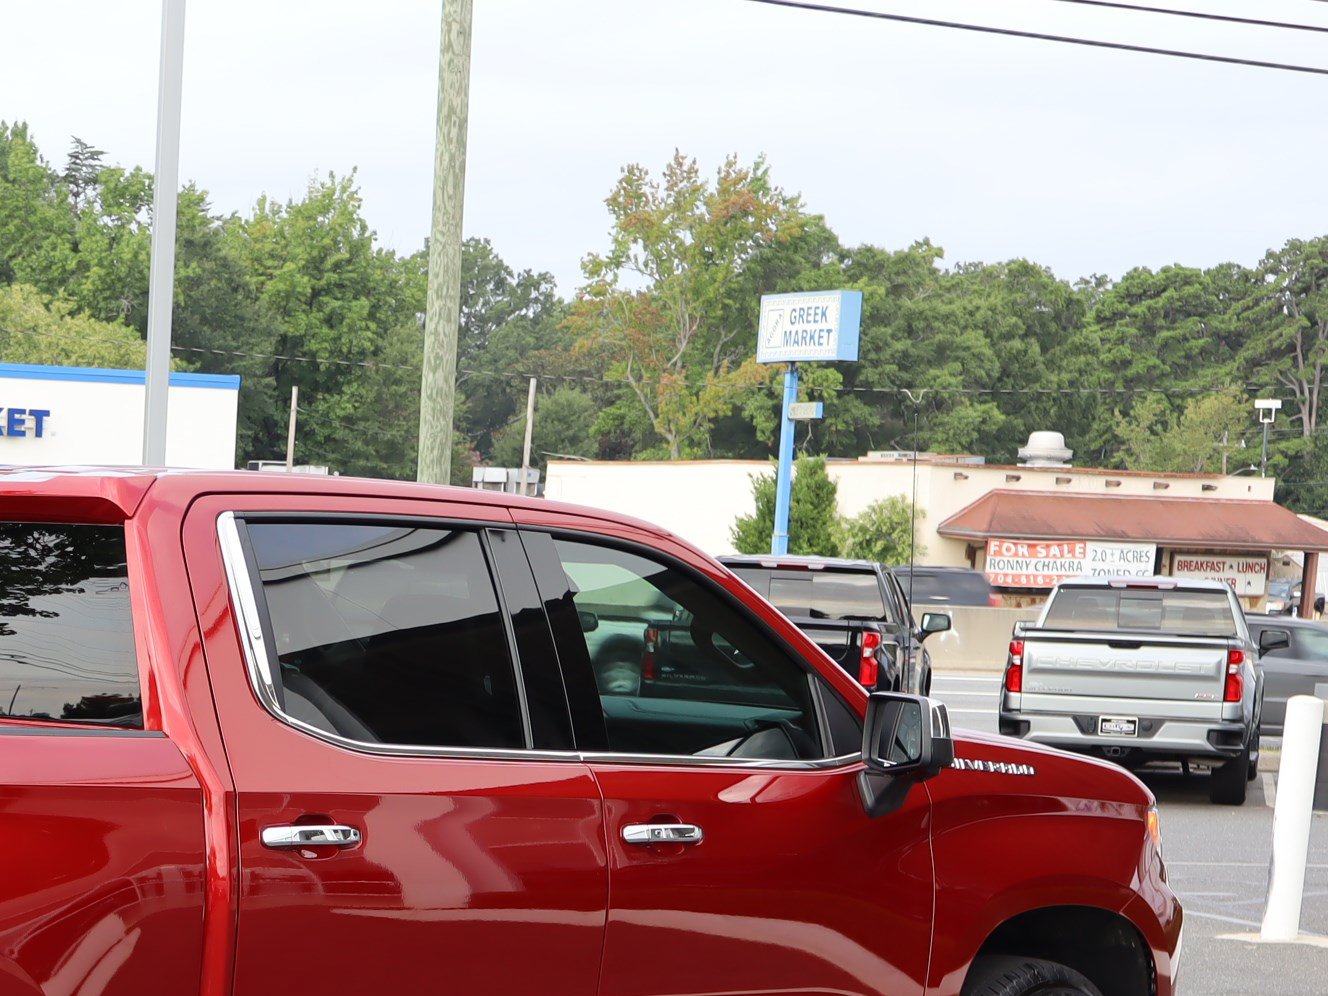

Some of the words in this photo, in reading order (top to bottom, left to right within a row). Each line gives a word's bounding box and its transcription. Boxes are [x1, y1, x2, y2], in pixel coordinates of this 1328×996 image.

[790, 305, 829, 325] GREEK
[783, 328, 833, 347] MARKET
[989, 541, 1029, 557] FOR
[1036, 543, 1085, 558] SALE
[1091, 549, 1107, 562] 2.0
[1119, 549, 1151, 563] ACRES
[989, 558, 1031, 572] RONNY
[1034, 560, 1083, 573] CHAKRA
[1177, 560, 1227, 573] BREAKFAST
[1237, 562, 1266, 574] LUNCH
[1036, 656, 1212, 673] CHEVROLET
